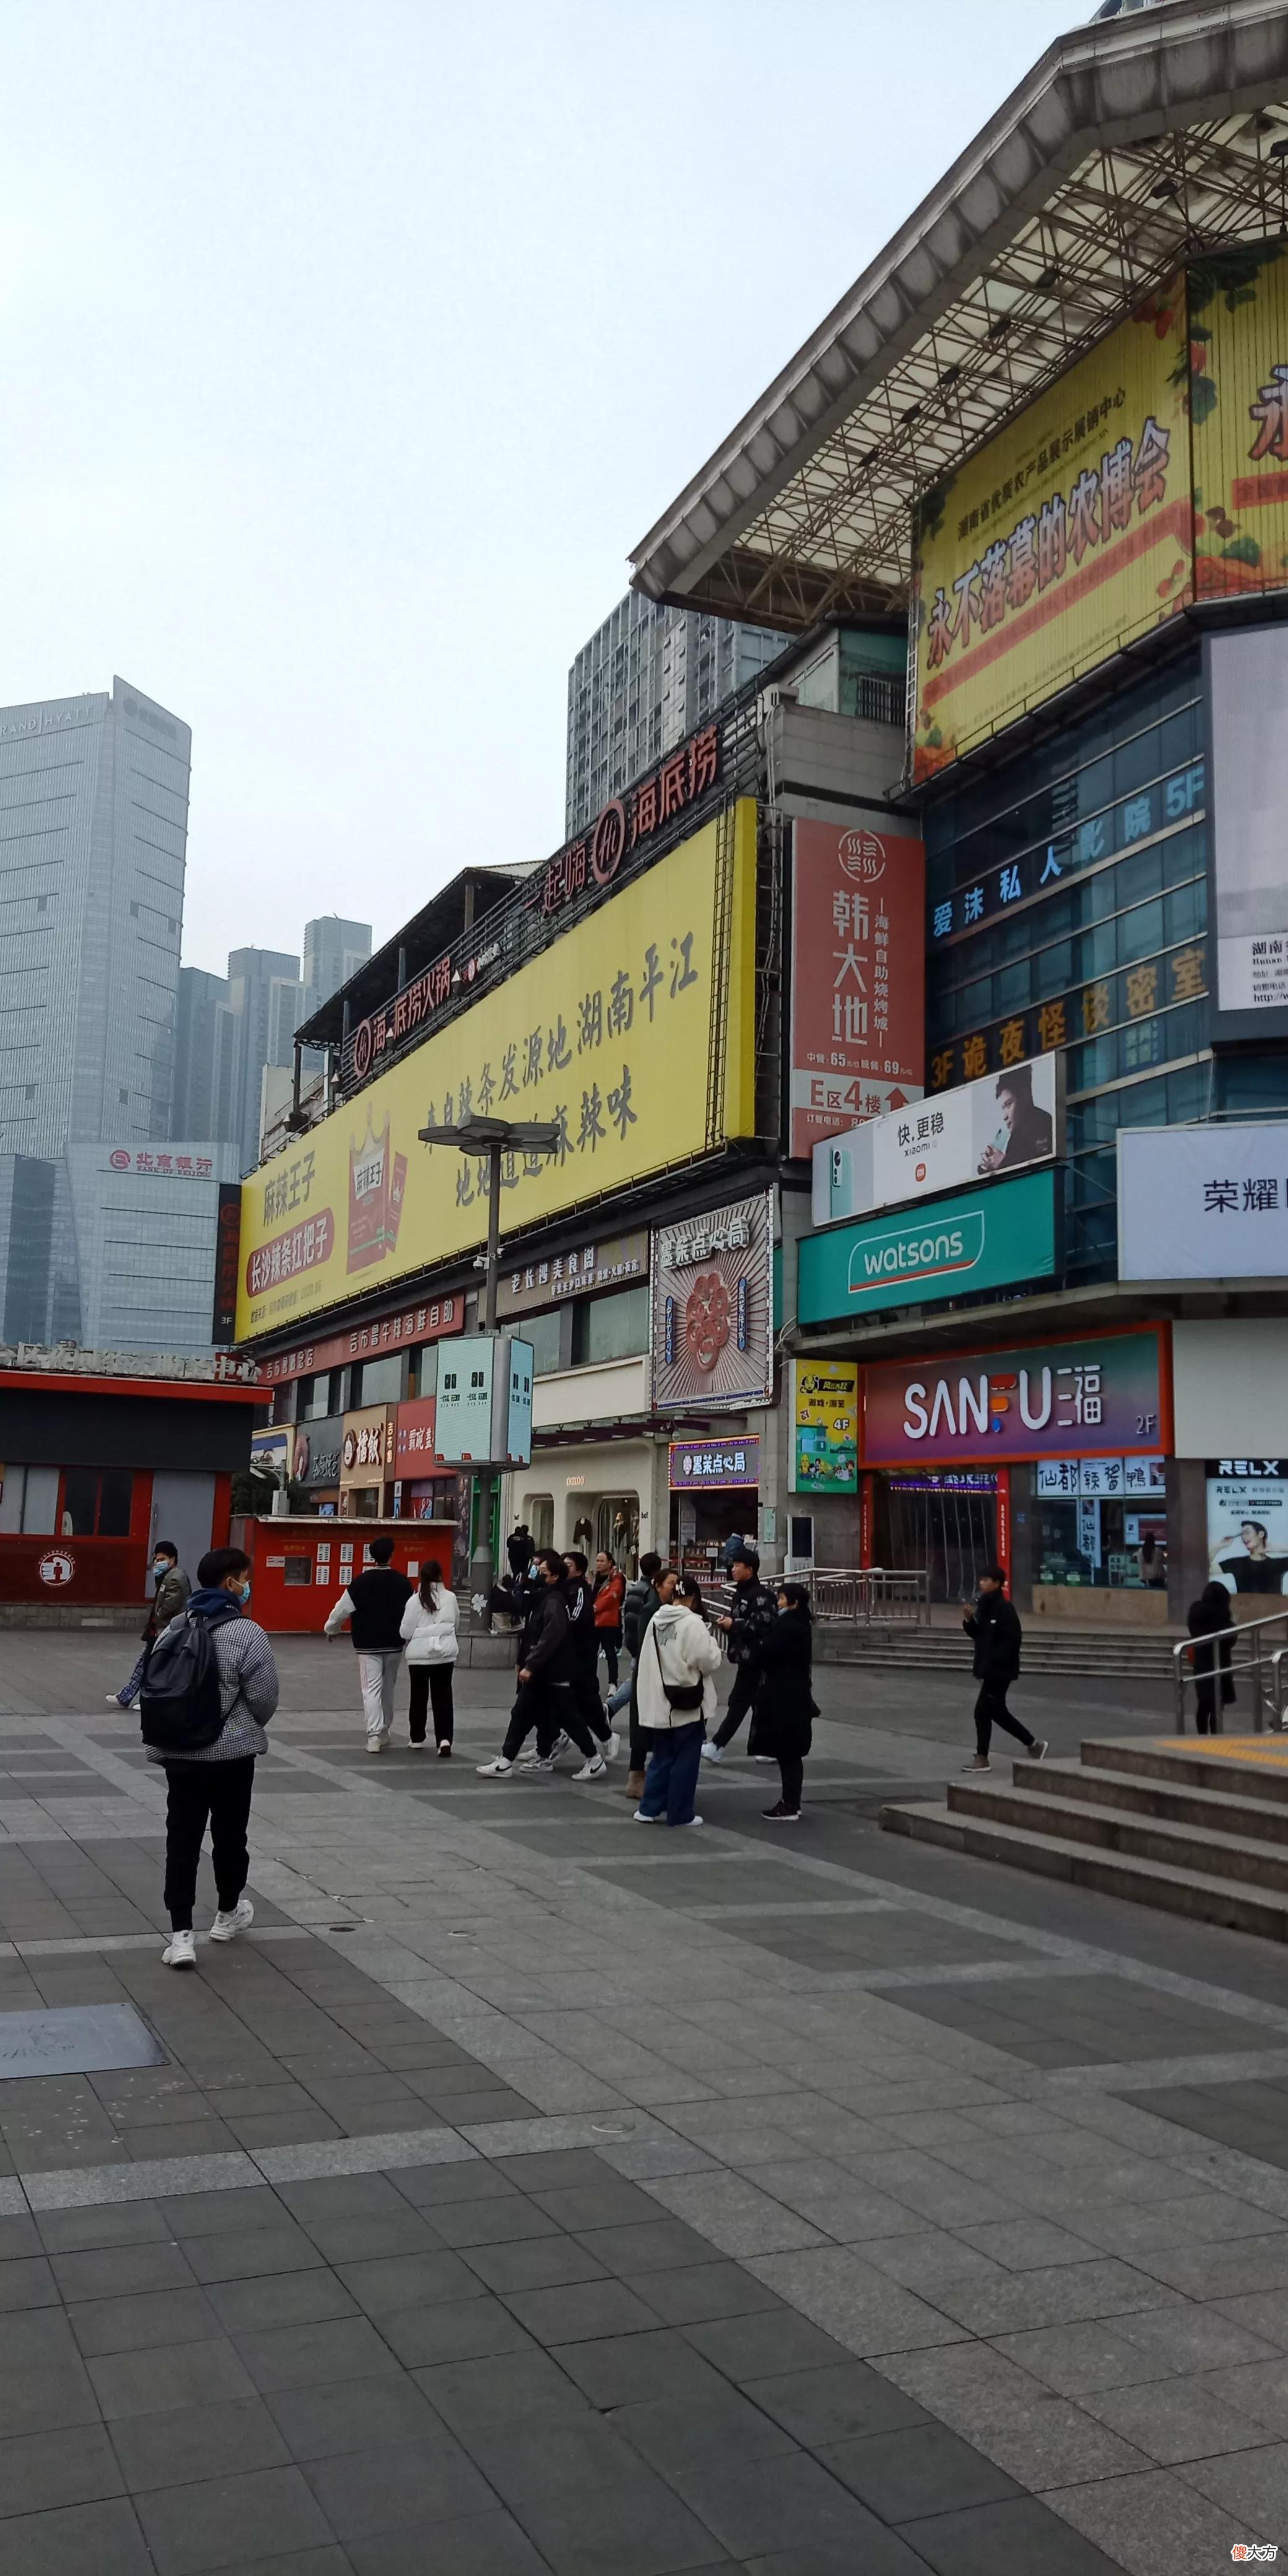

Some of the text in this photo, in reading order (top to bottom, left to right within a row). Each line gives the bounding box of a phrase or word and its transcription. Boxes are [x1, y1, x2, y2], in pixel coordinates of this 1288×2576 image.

[927, 416, 1170, 669] 永不落幕的农博会
[630, 723, 718, 849] 海底捞
[1166, 765, 1205, 818] 5F
[1252, 939, 1288, 955] 湖南
[832, 889, 869, 1045] 韩大地
[874, 915, 890, 1031] 海鲜自助烧烤城
[811, 1079, 882, 1114] E区4楼
[136, 1152, 213, 1172] 北京银行
[263, 1150, 316, 1229] 麻辣王子
[1203, 1178, 1280, 1213] 荣耀
[250, 1217, 329, 1292] 长沙辣条扛把子
[864, 1231, 964, 1276] watsons
[220, 1316, 233, 1325] 3F
[833, 1418, 850, 1430] 4F
[1135, 1414, 1157, 1435] 2F
[692, 1451, 746, 1476] 墨茉点心局
[1218, 1460, 1279, 1476] RELX
